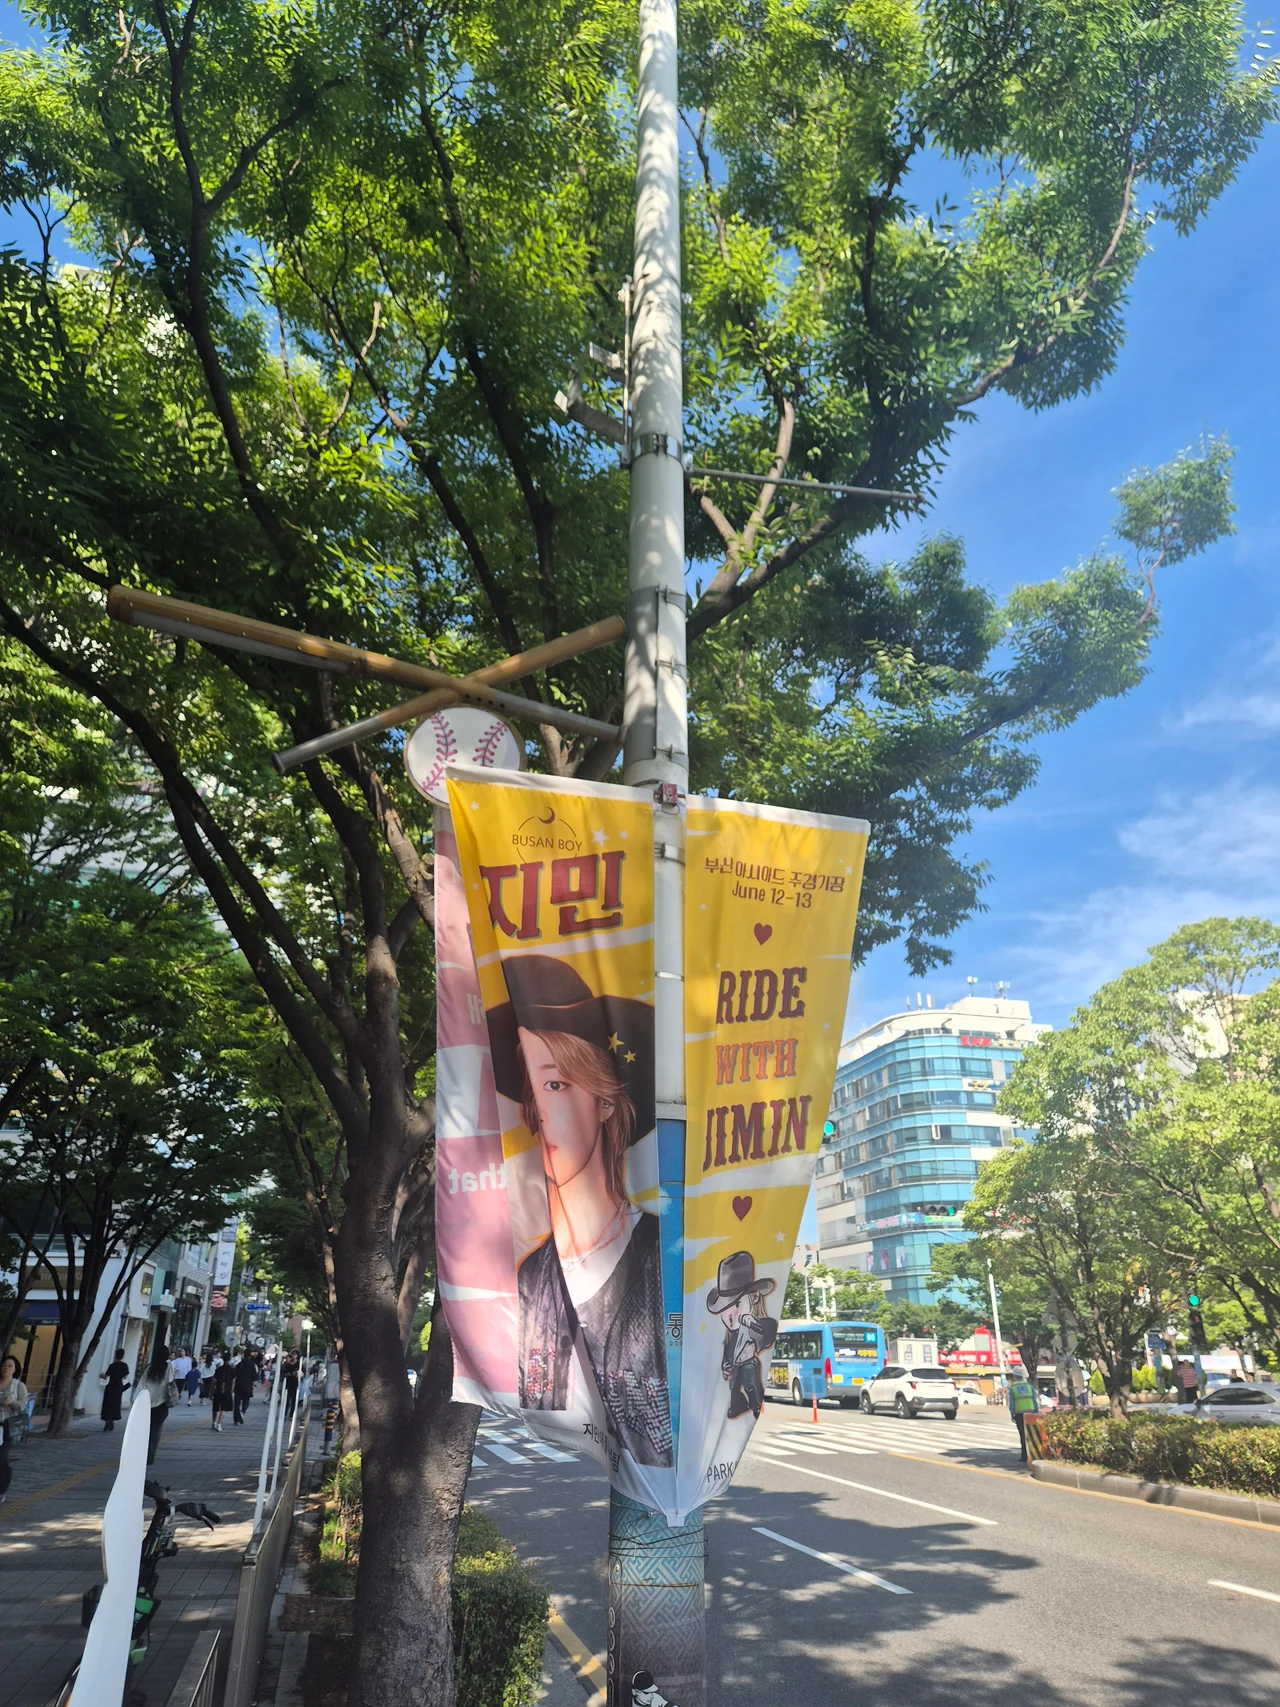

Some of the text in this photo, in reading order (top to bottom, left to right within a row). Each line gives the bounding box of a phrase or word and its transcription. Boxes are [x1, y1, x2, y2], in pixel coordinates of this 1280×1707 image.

[511, 834, 582, 852] BUSAN BOY
[479, 850, 626, 941] 지민
[704, 857, 734, 874] 부산
[788, 871, 846, 893] 주경기장
[732, 881, 813, 909] June 12-13
[716, 967, 807, 1025] RIDE
[716, 1038, 798, 1085] WITH
[702, 1095, 813, 1172] JIMIN
[706, 1461, 733, 1483] PARK
